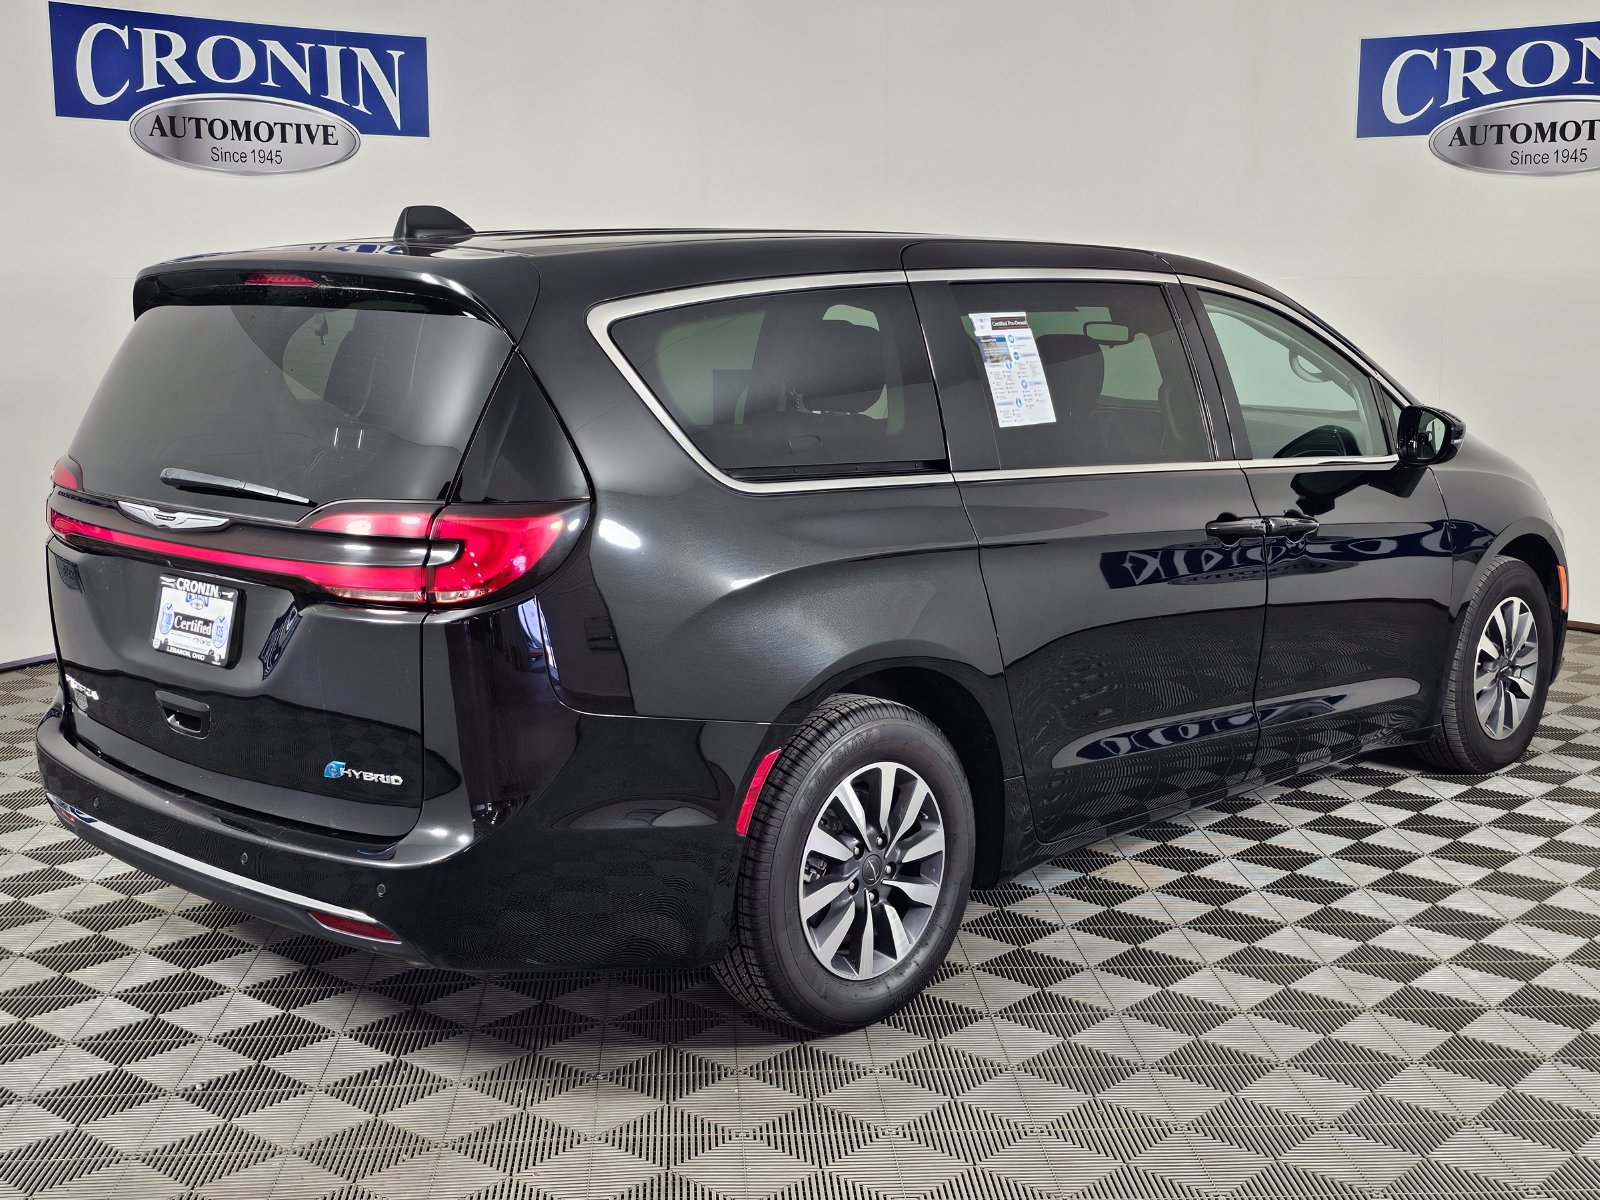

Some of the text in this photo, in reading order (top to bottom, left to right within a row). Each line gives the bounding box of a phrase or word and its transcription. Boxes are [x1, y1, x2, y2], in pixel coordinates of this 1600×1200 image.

[76, 22, 405, 131] CRONIN
[148, 115, 339, 146] AUTOMOTIVE
[210, 147, 283, 166] Since 1945
[1510, 148, 1588, 166] Since 1945
[176, 577, 219, 598] CRONIN
[174, 615, 212, 635] Certified
